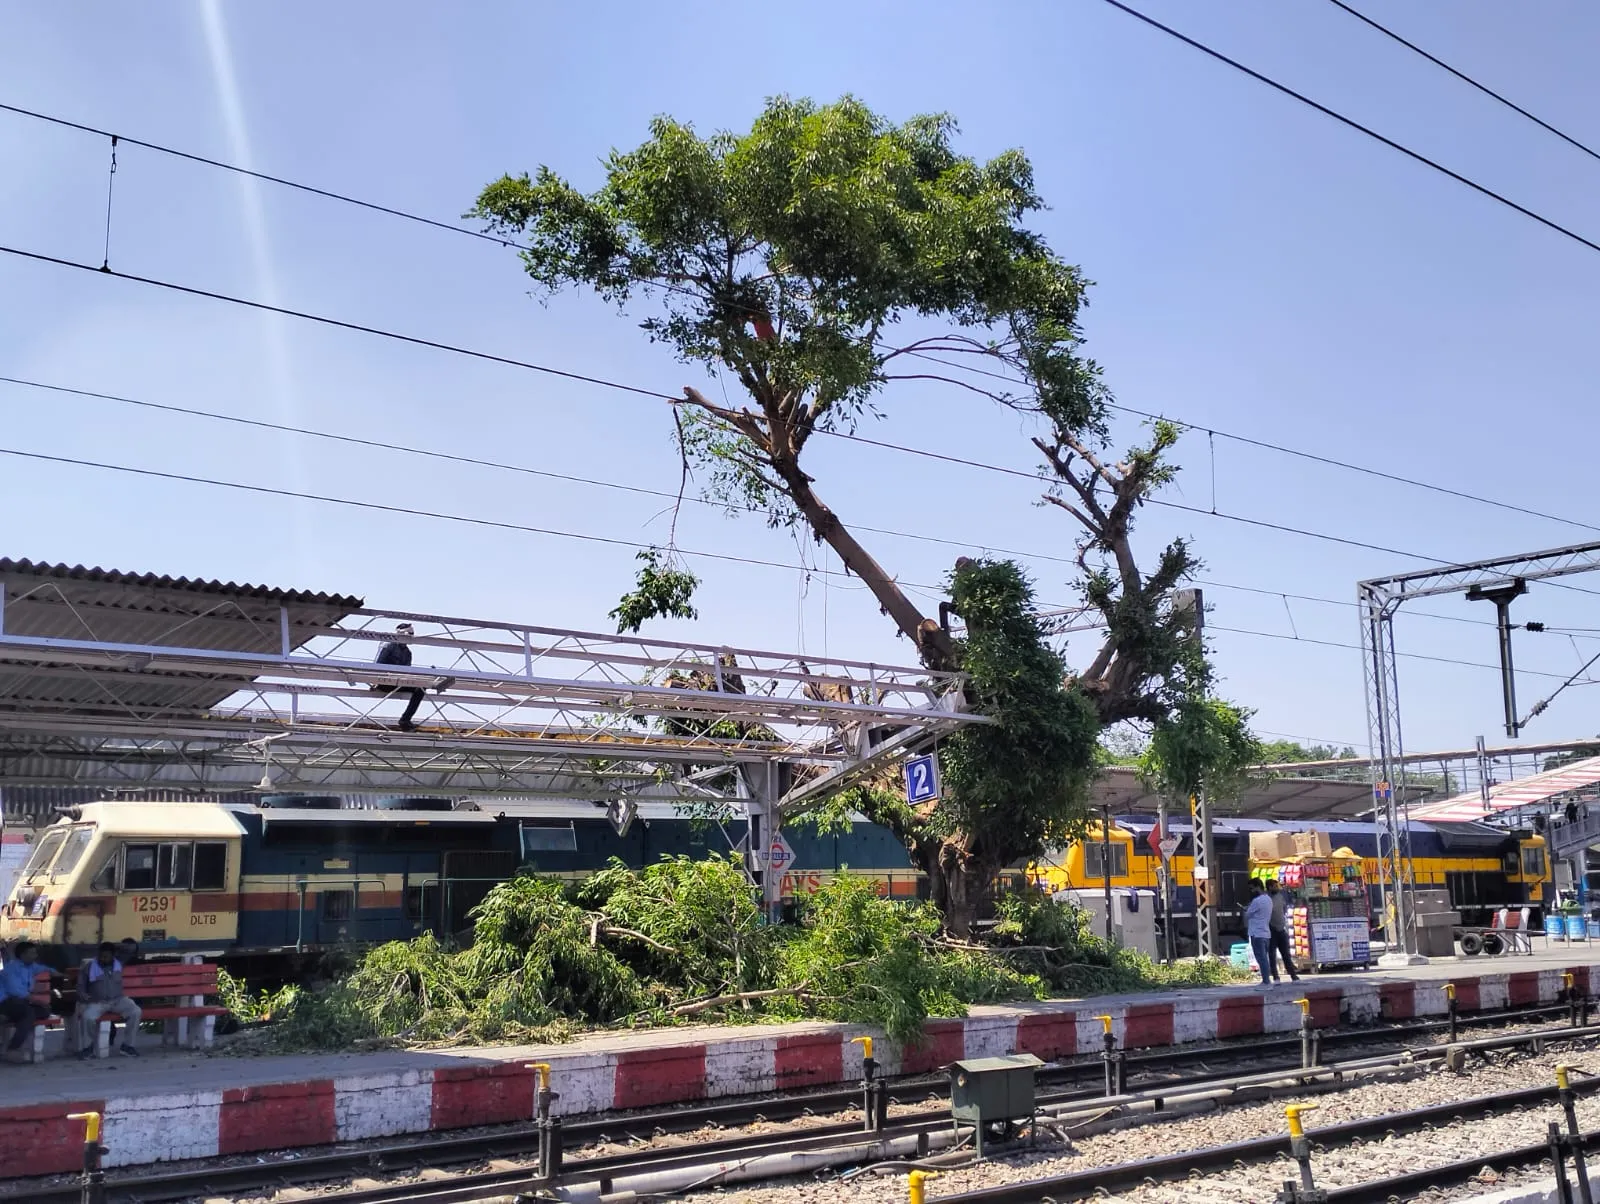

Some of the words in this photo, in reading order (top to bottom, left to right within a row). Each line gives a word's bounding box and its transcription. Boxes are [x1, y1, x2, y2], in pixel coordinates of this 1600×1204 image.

[913, 763, 929, 797] 2
[780, 870, 821, 895] AYS
[132, 896, 177, 912] 12591
[142, 914, 168, 924] WDG4
[190, 914, 217, 926] DLTB
